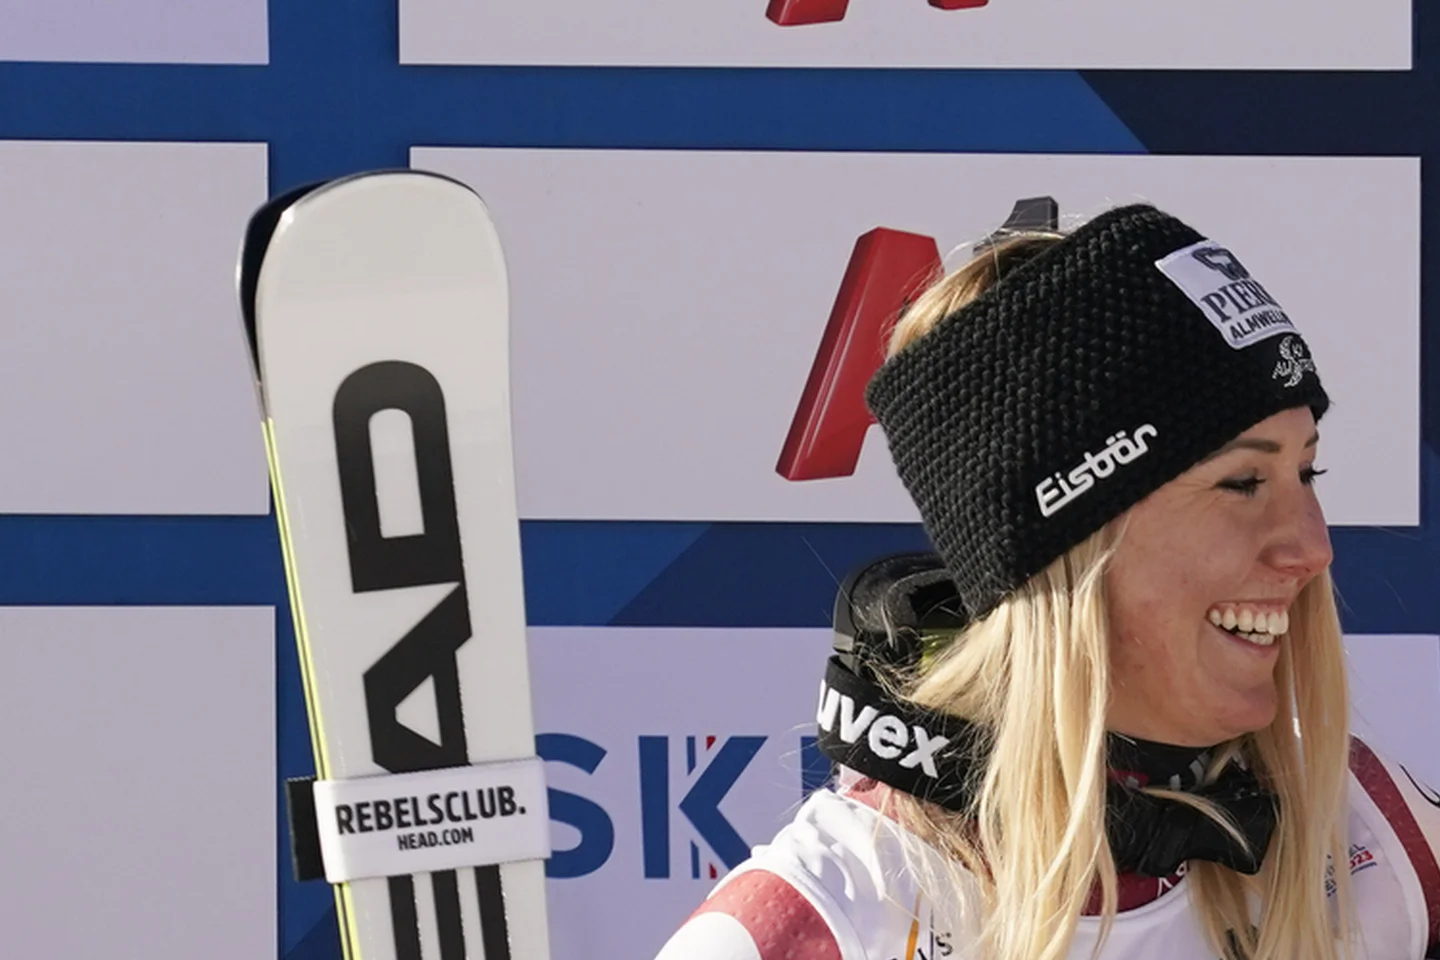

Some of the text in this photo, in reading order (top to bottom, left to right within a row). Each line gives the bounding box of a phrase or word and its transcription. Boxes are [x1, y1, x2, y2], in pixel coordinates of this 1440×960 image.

[1035, 423, 1158, 517] Eisbär
[816, 678, 950, 779] uvex
[335, 785, 527, 836] REBELSCLUB.
[397, 827, 475, 851] HEAD.COM
[534, 732, 838, 879] SK
